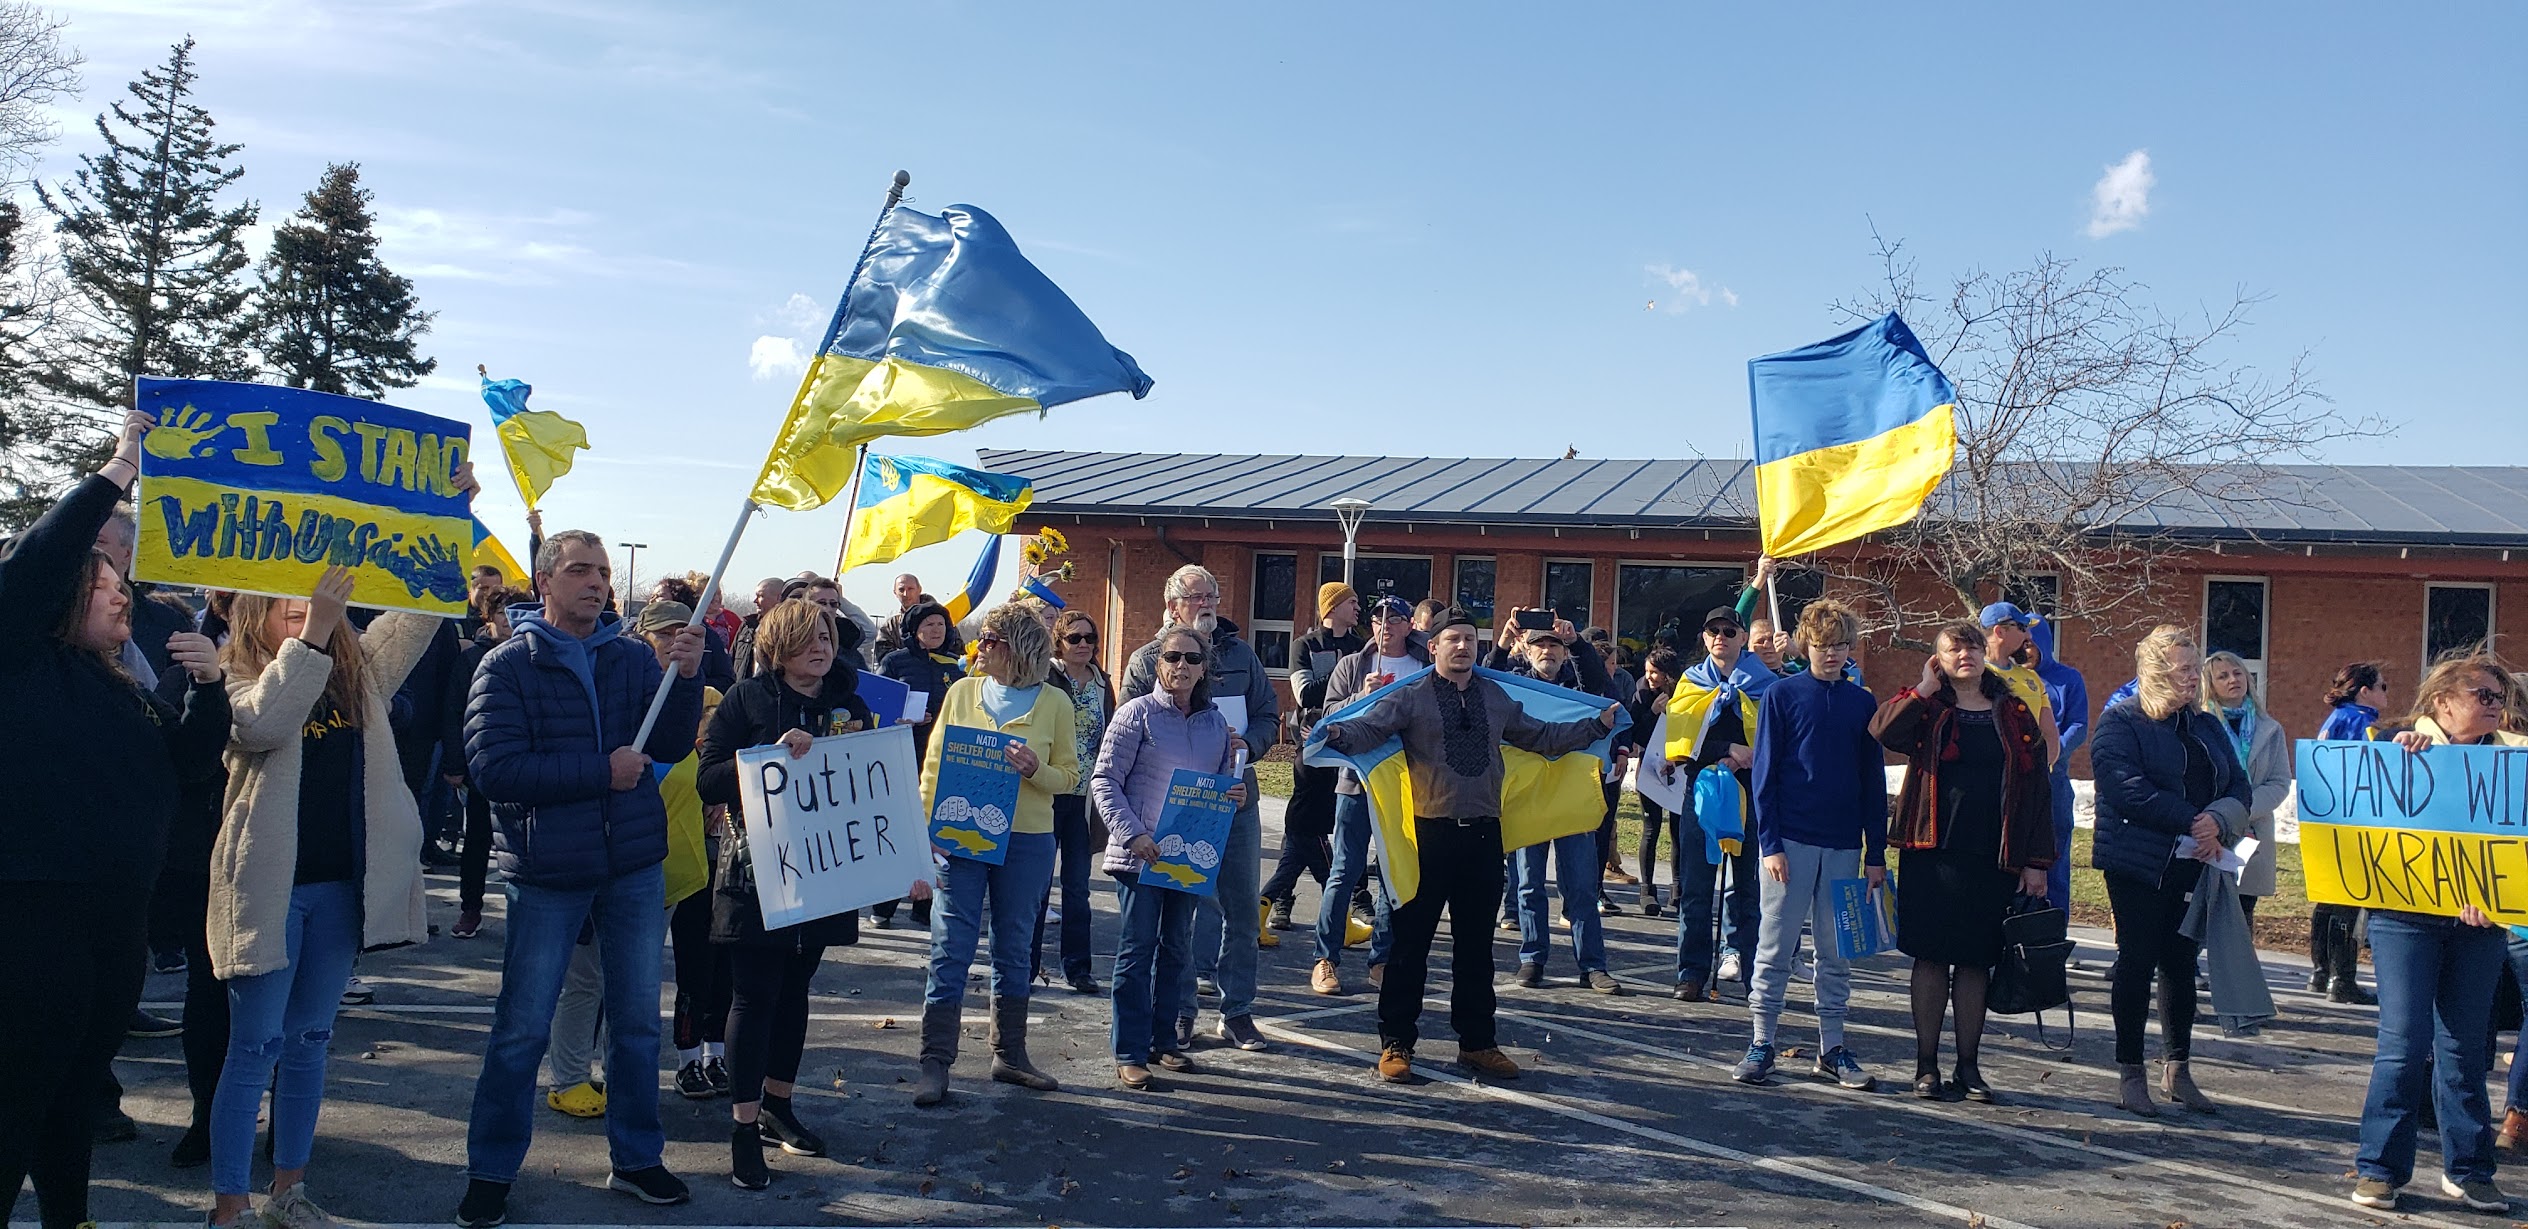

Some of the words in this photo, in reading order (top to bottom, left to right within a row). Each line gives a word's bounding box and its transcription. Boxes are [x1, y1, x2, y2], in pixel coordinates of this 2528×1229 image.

[226, 411, 284, 466] I
[309, 415, 470, 499] STAND
[976, 734, 998, 747] NATO
[947, 742, 984, 757] SHELTER
[985, 748, 1003, 761] OUR
[761, 752, 890, 829] Putin
[1196, 777, 1215, 789] NATO
[2300, 744, 2435, 818] STAND
[1171, 785, 1202, 798] SHELTER
[1202, 789, 1218, 801] OUR
[1846, 901, 1855, 919] OUR
[1841, 910, 1850, 931] NATO
